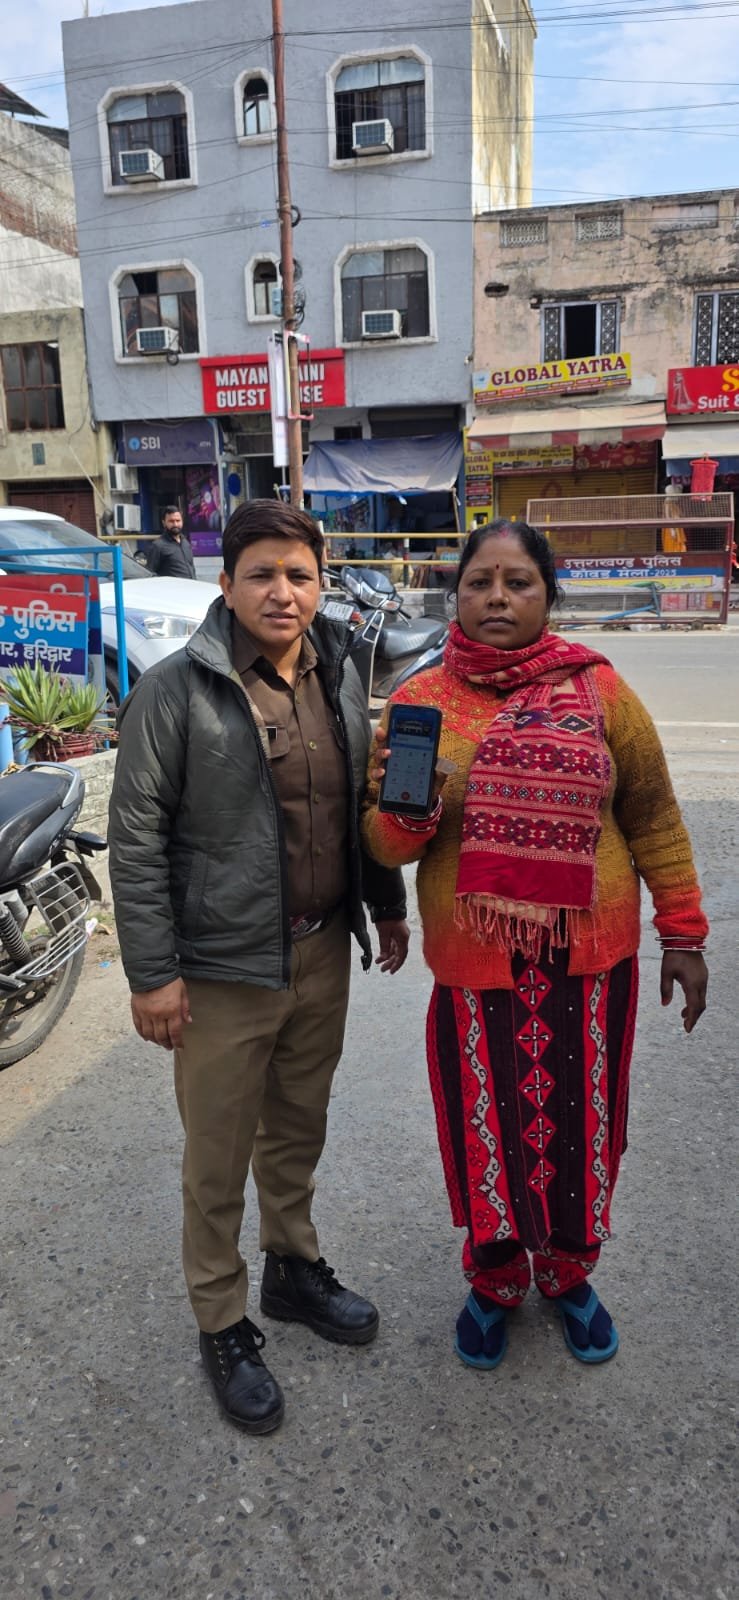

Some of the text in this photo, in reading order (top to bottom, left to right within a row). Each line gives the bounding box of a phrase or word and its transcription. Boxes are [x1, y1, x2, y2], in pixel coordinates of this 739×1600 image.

[215, 363, 325, 387] MAYAN AINI
[491, 364, 562, 387] GLOBAL
[566, 355, 627, 376] YATRA
[721, 367, 739, 393] S
[216, 388, 267, 408] GUEST
[697, 394, 730, 410] Suit
[140, 436, 161, 450] SBI
[464, 455, 490, 463] GLOBAL
[563, 554, 682, 570] उत्तराखण्ड पुलिस
[11, 599, 78, 640] पुलिस
[23, 639, 73, 663] हरिद्वार
